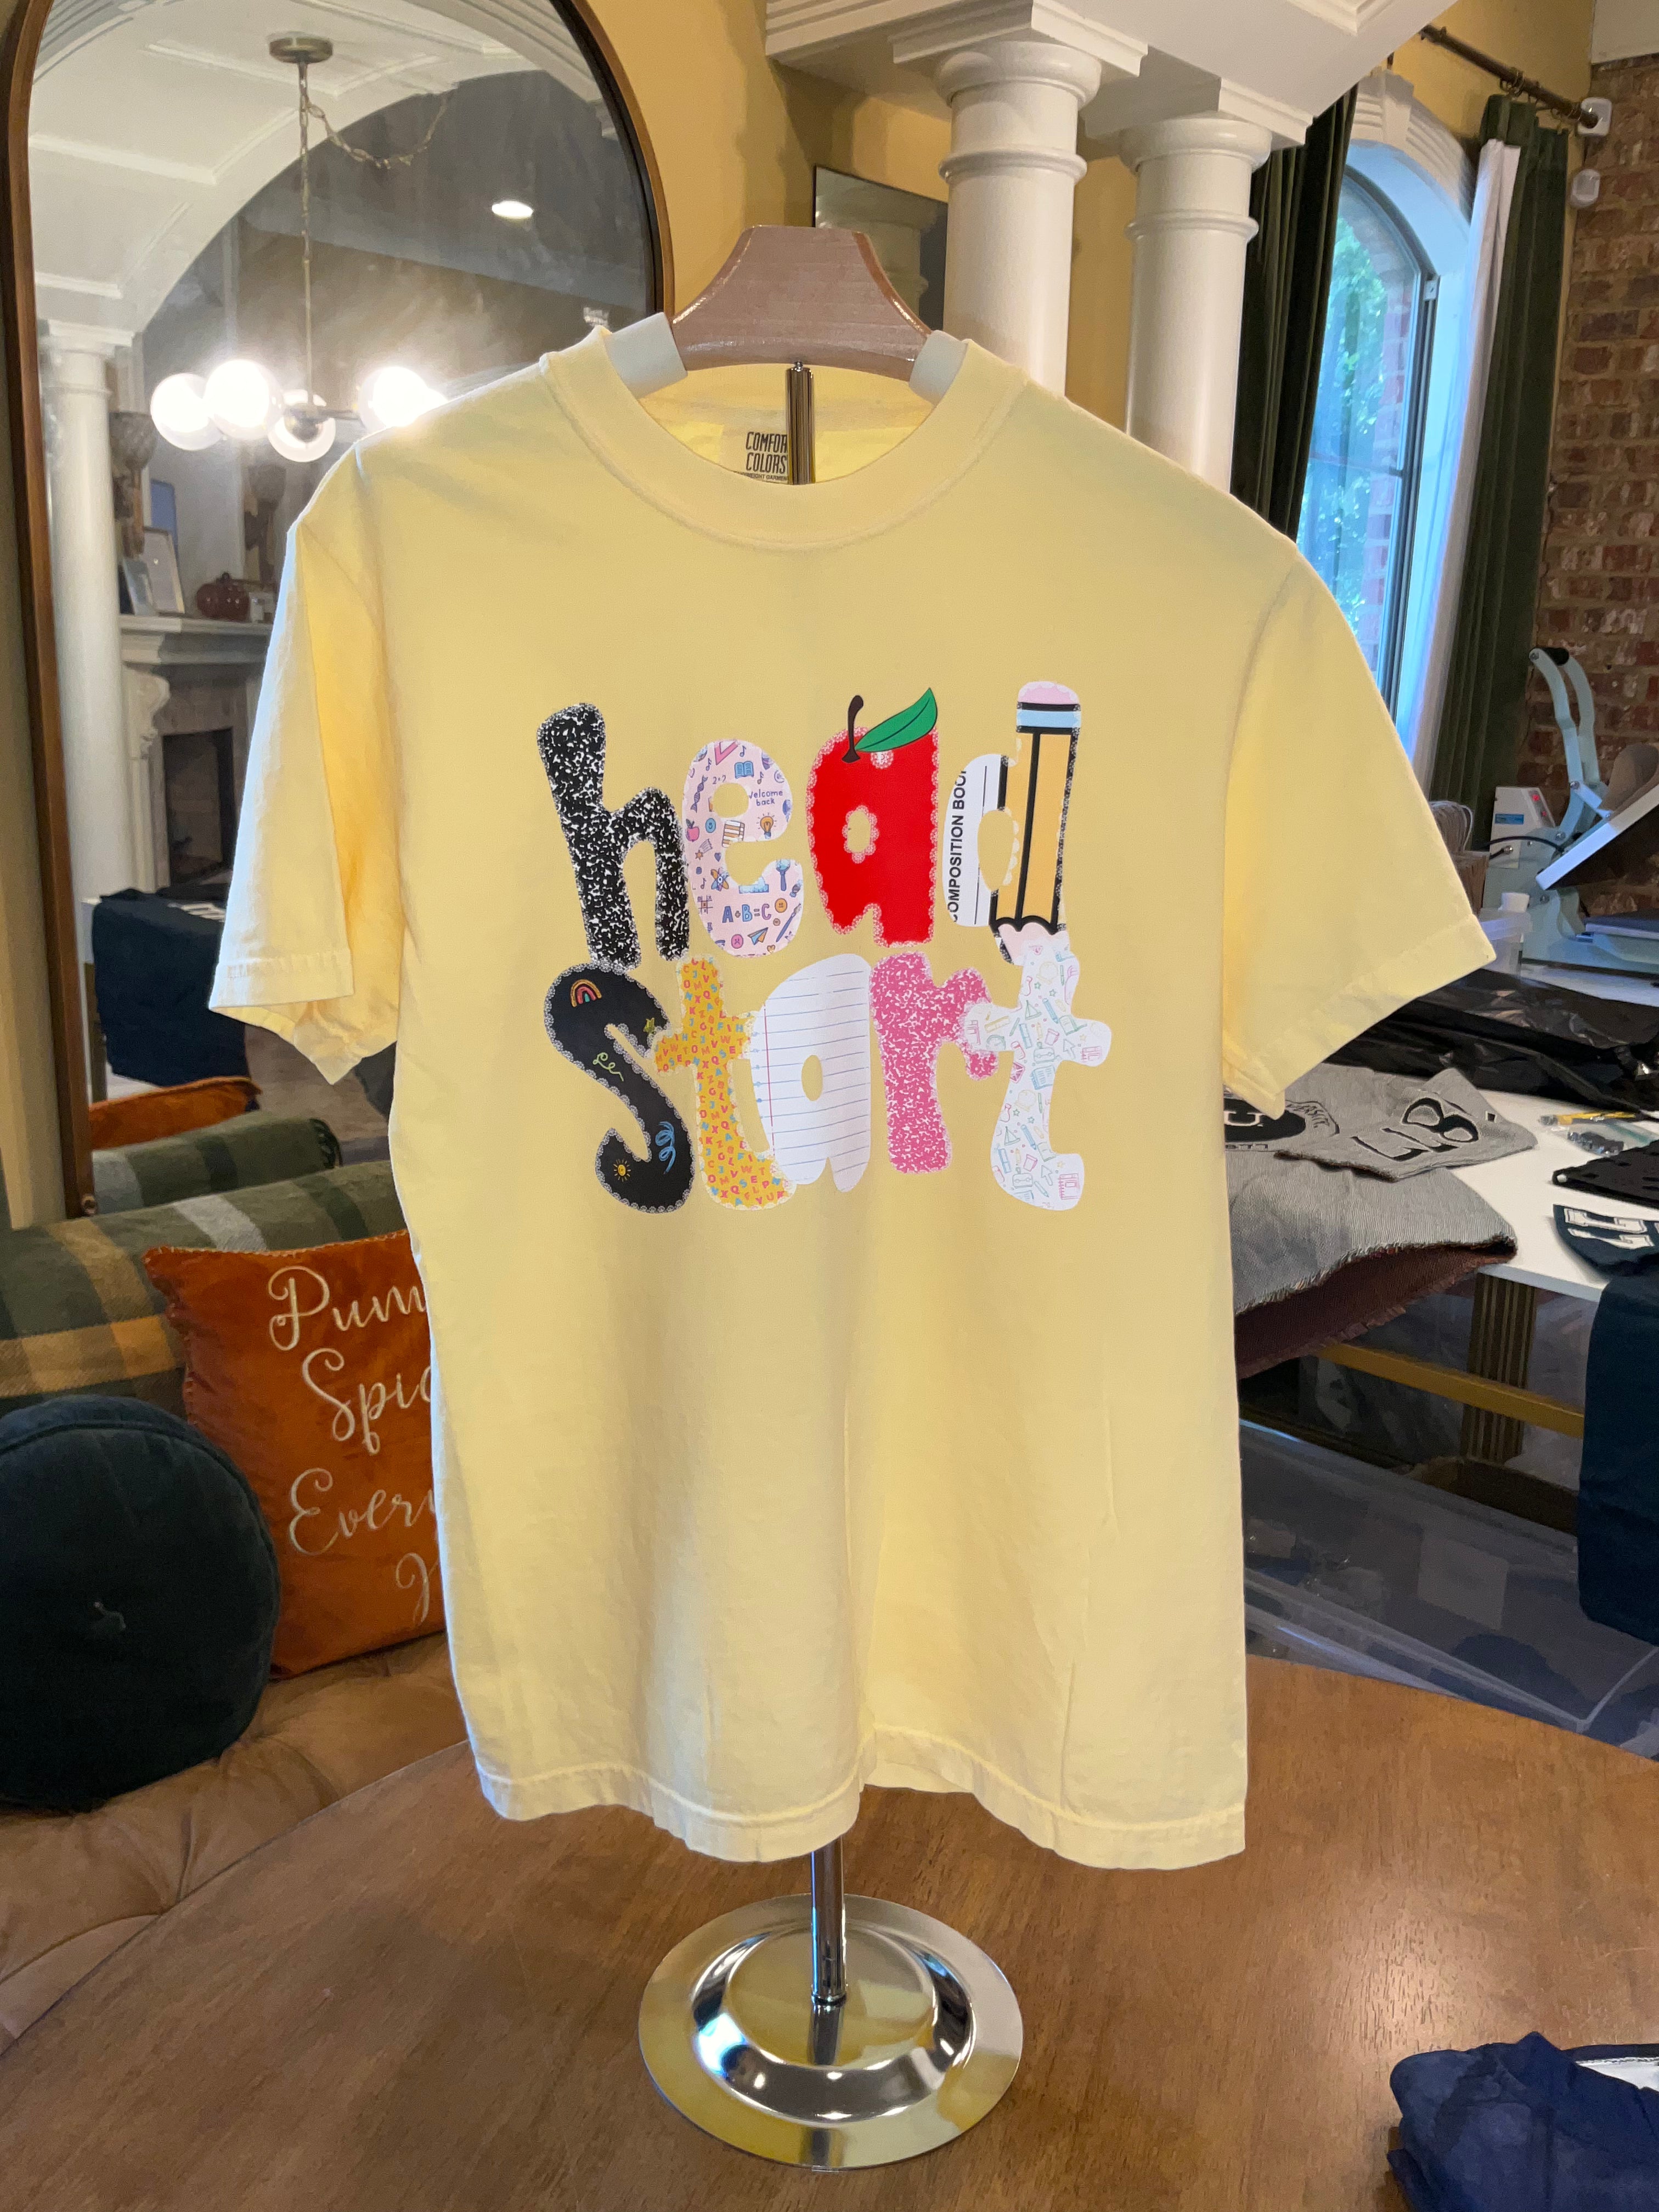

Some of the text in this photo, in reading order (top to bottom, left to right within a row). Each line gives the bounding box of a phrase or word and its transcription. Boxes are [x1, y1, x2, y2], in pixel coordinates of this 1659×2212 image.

[746, 431, 788, 453] COMFOR
[746, 452, 786, 474] COLORS
[756, 798, 775, 806] back
[952, 771, 967, 810] BOO
[536, 681, 1081, 972] head
[268, 1266, 426, 1351] Pum
[302, 1348, 431, 1454] Spic
[289, 1468, 436, 1555] Ever
